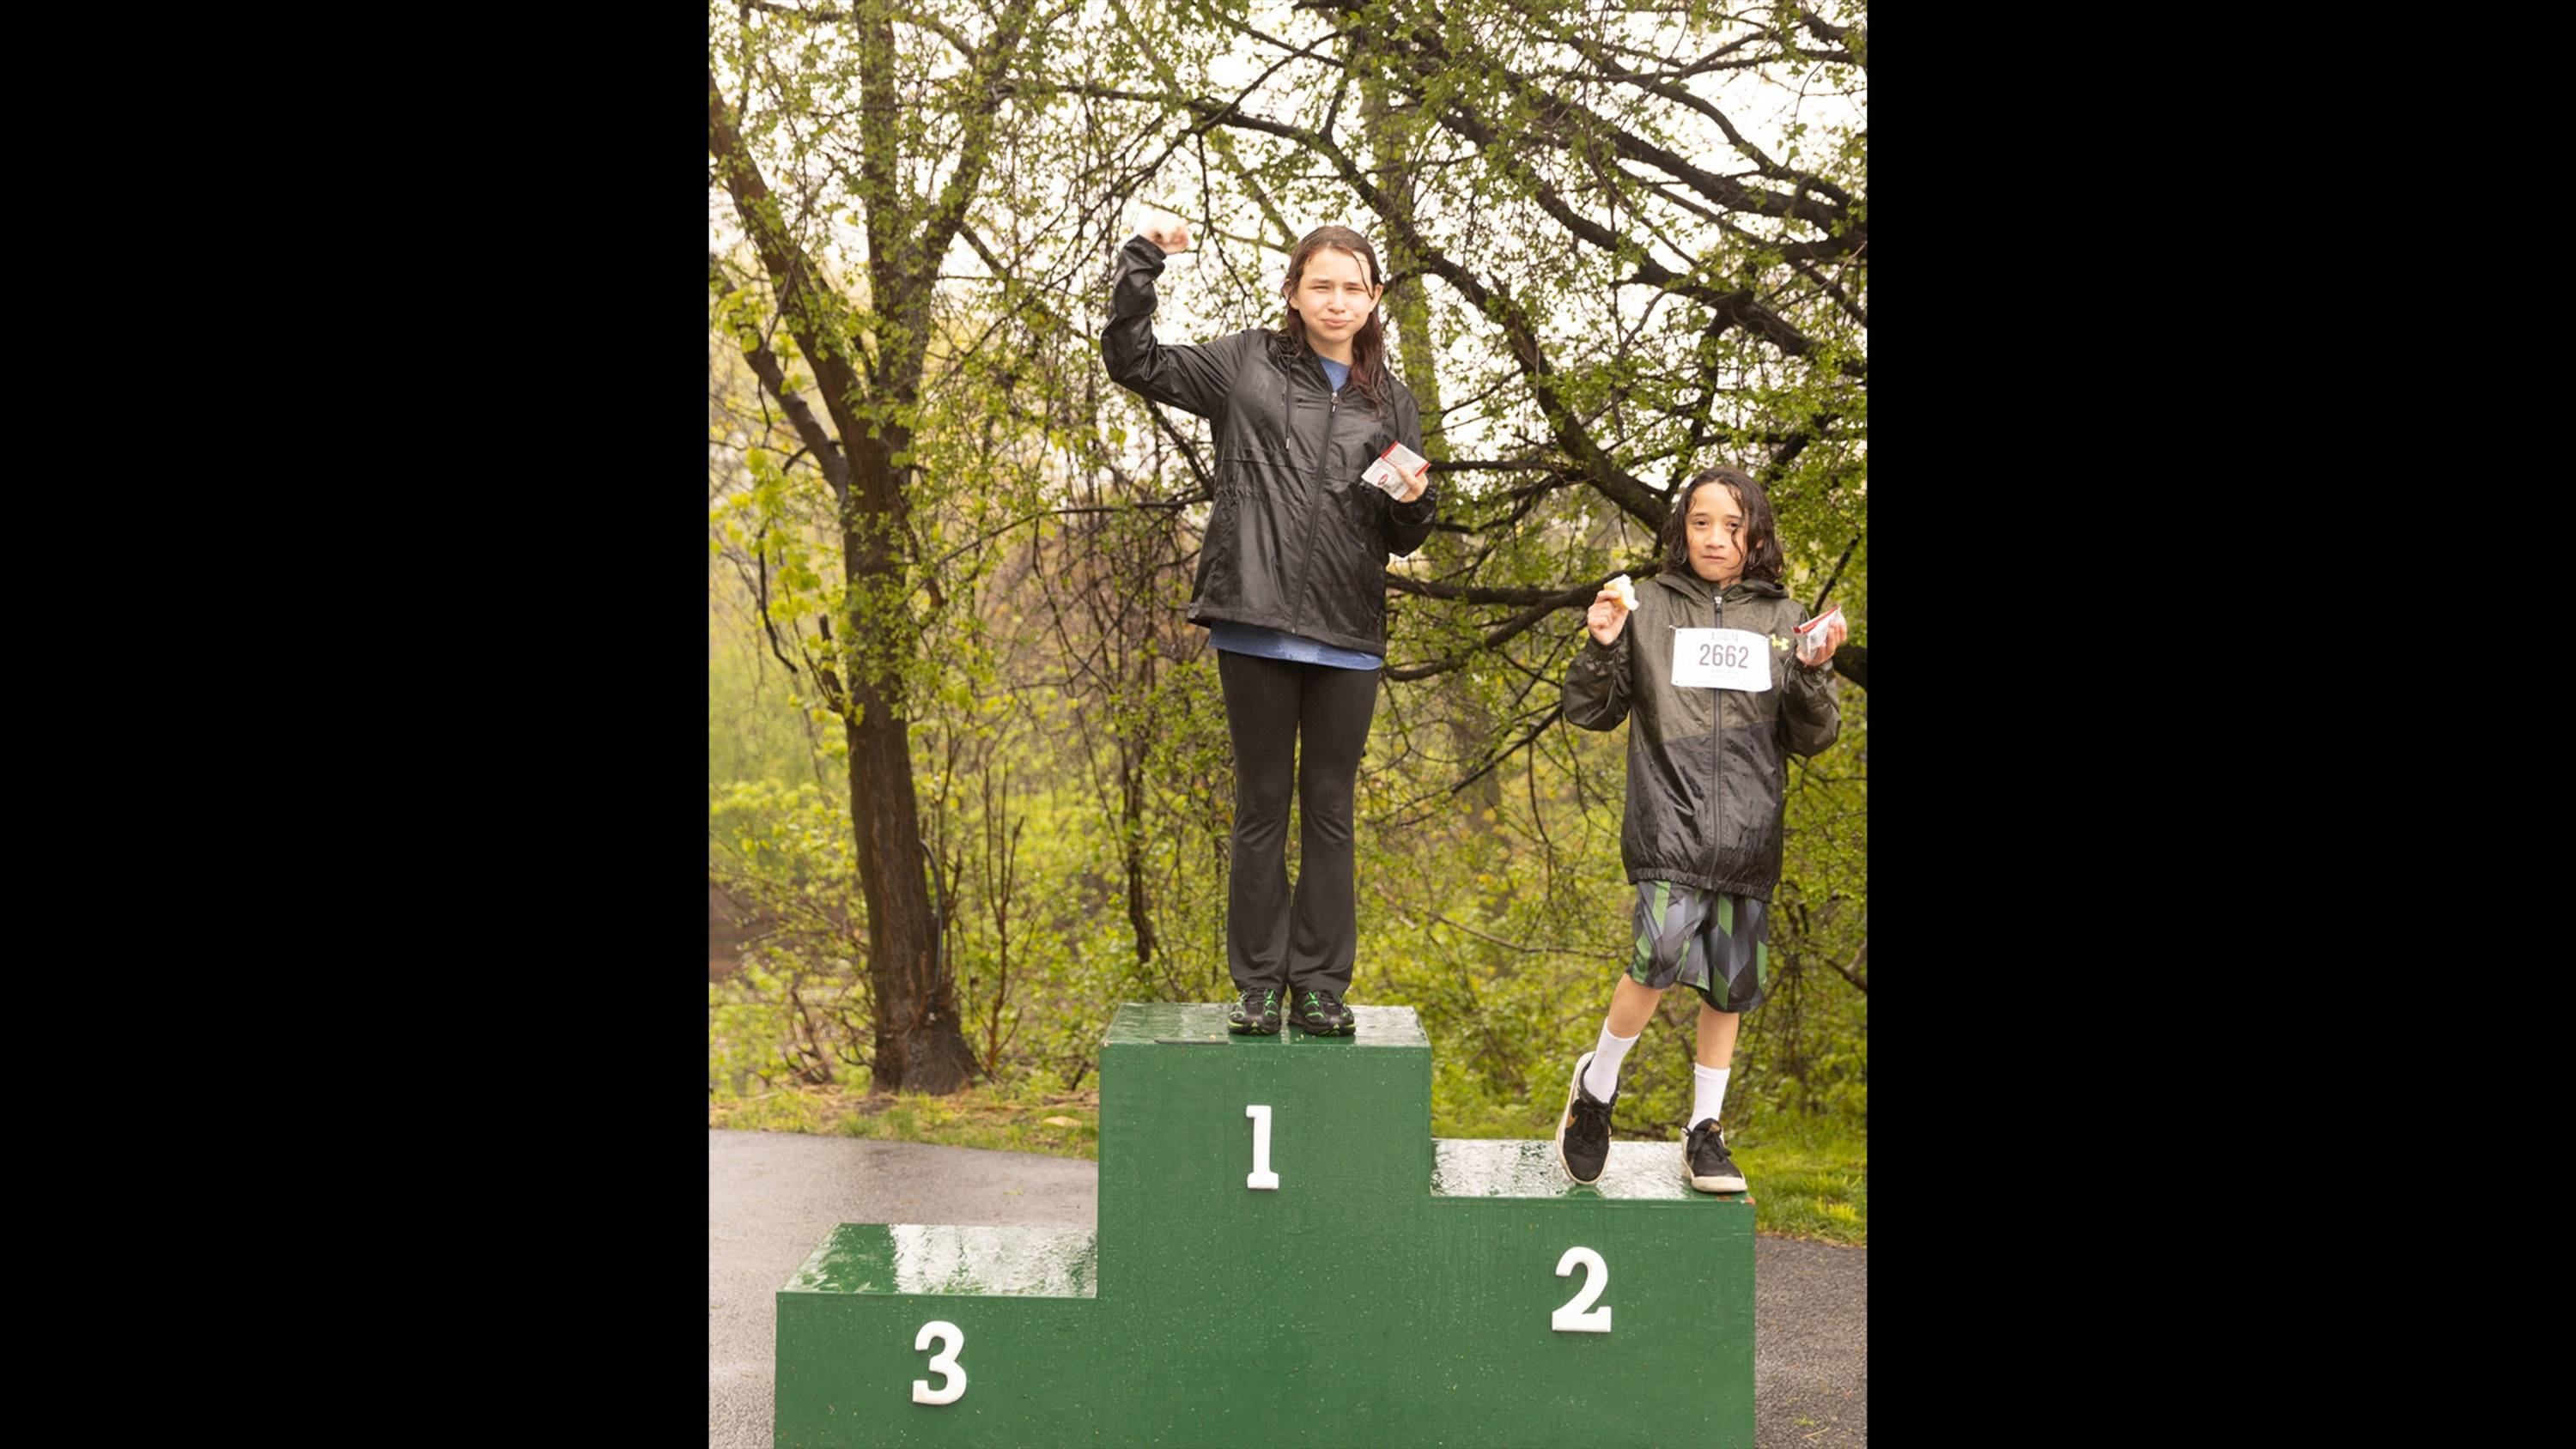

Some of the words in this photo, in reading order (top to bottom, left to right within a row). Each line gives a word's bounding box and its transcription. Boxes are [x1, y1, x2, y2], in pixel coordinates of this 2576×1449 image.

[1699, 643, 1749, 669] 2662
[1246, 1105, 1279, 1190] 1
[1552, 1246, 1612, 1332] 2
[913, 1321, 966, 1404] 3
